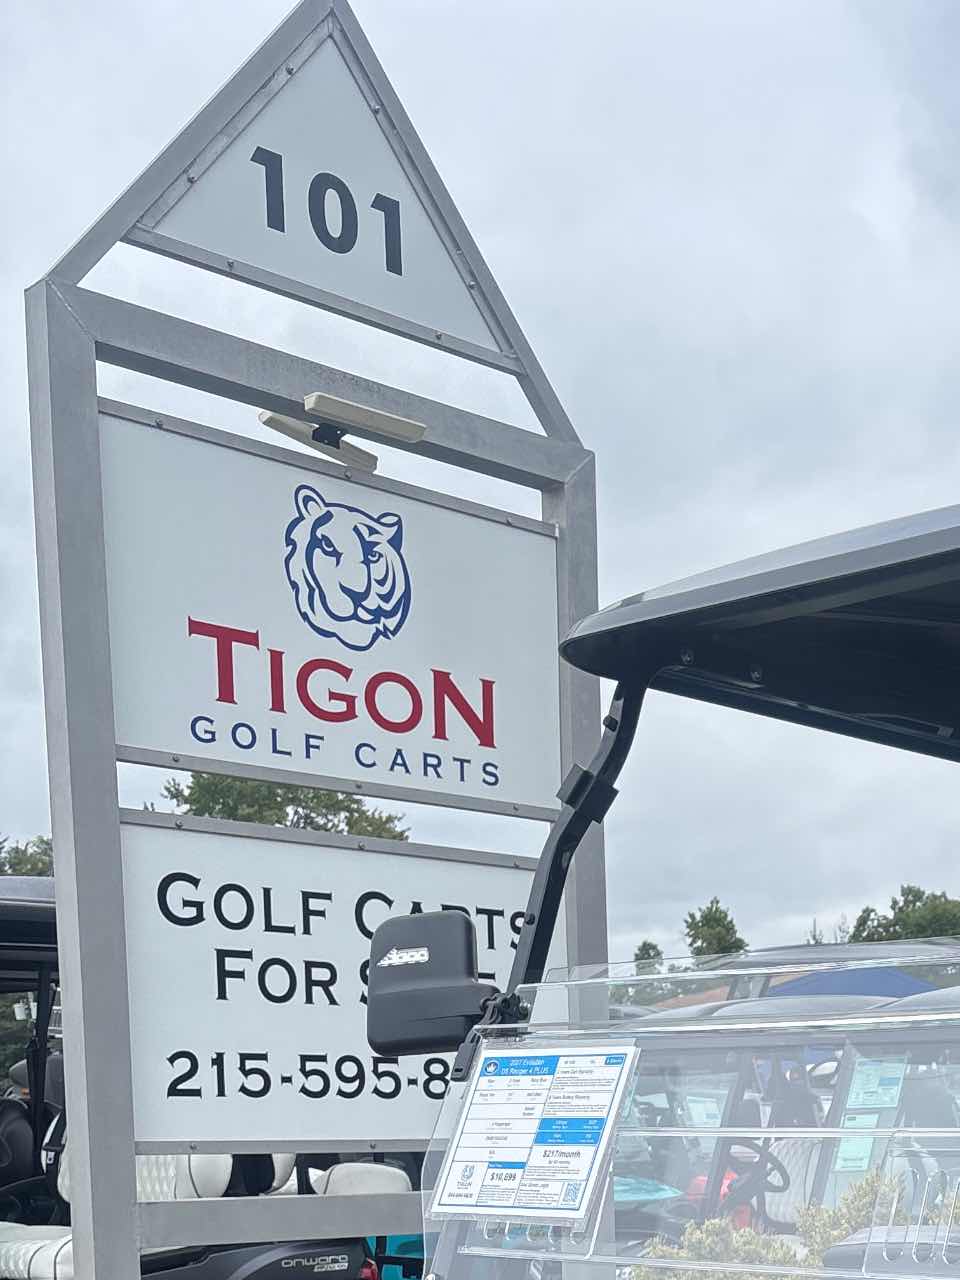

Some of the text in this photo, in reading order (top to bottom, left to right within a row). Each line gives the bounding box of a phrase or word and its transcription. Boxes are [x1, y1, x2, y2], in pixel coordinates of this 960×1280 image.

[249, 145, 405, 277] 101
[188, 615, 497, 749] TIGON
[190, 715, 501, 787] GOLF CARTS
[157, 871, 526, 951] GOLF CTS
[215, 947, 340, 1006] FOR
[165, 1049, 453, 1101] 215-595-8
